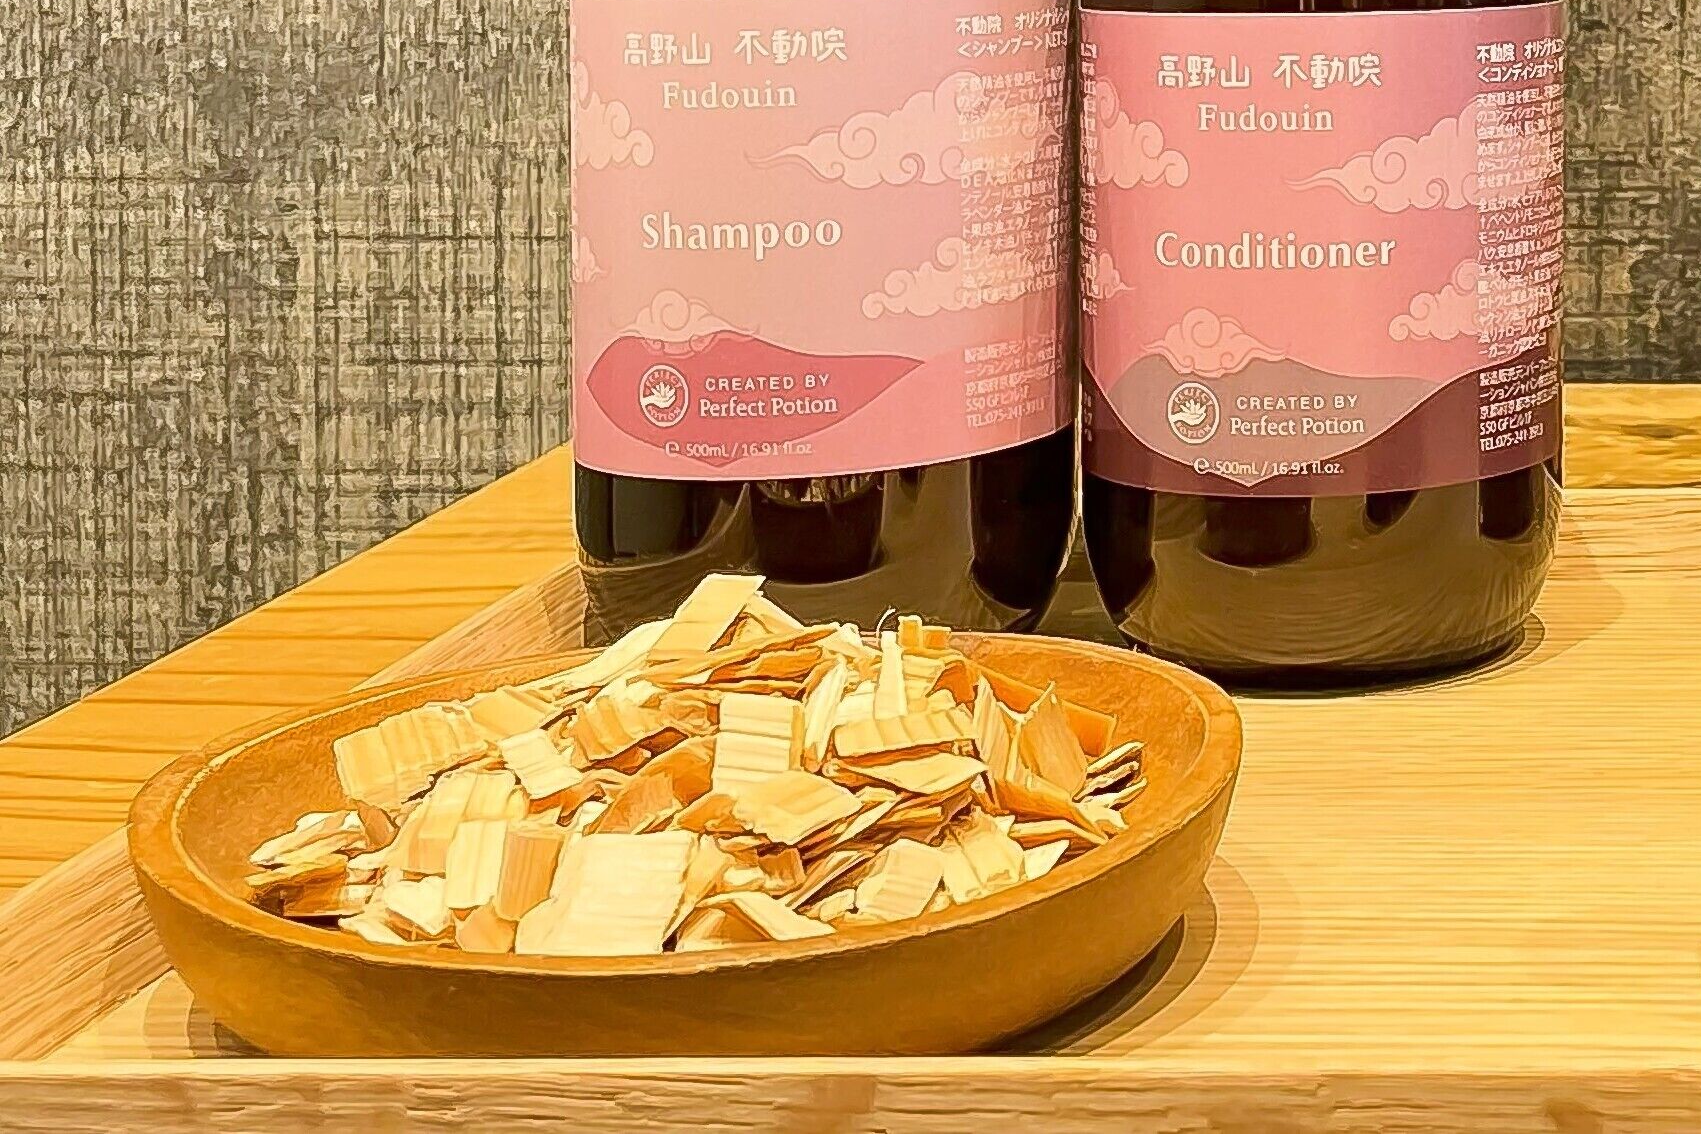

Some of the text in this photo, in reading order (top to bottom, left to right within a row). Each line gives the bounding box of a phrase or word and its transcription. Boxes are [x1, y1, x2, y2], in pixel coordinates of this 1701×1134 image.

[623, 27, 849, 67] 高野山 不動院
[1156, 53, 1383, 90] 高野山 不動院
[662, 79, 798, 110] Fudouin
[1198, 104, 1335, 133] Fudouin
[640, 211, 842, 261] Shampoo
[1153, 231, 1397, 269] Conditioner
[705, 373, 830, 392] CREATED BY
[700, 396, 838, 418] Perfect Potion
[1236, 394, 1359, 411] CREATED BY
[1229, 415, 1365, 436] Perfect Potion
